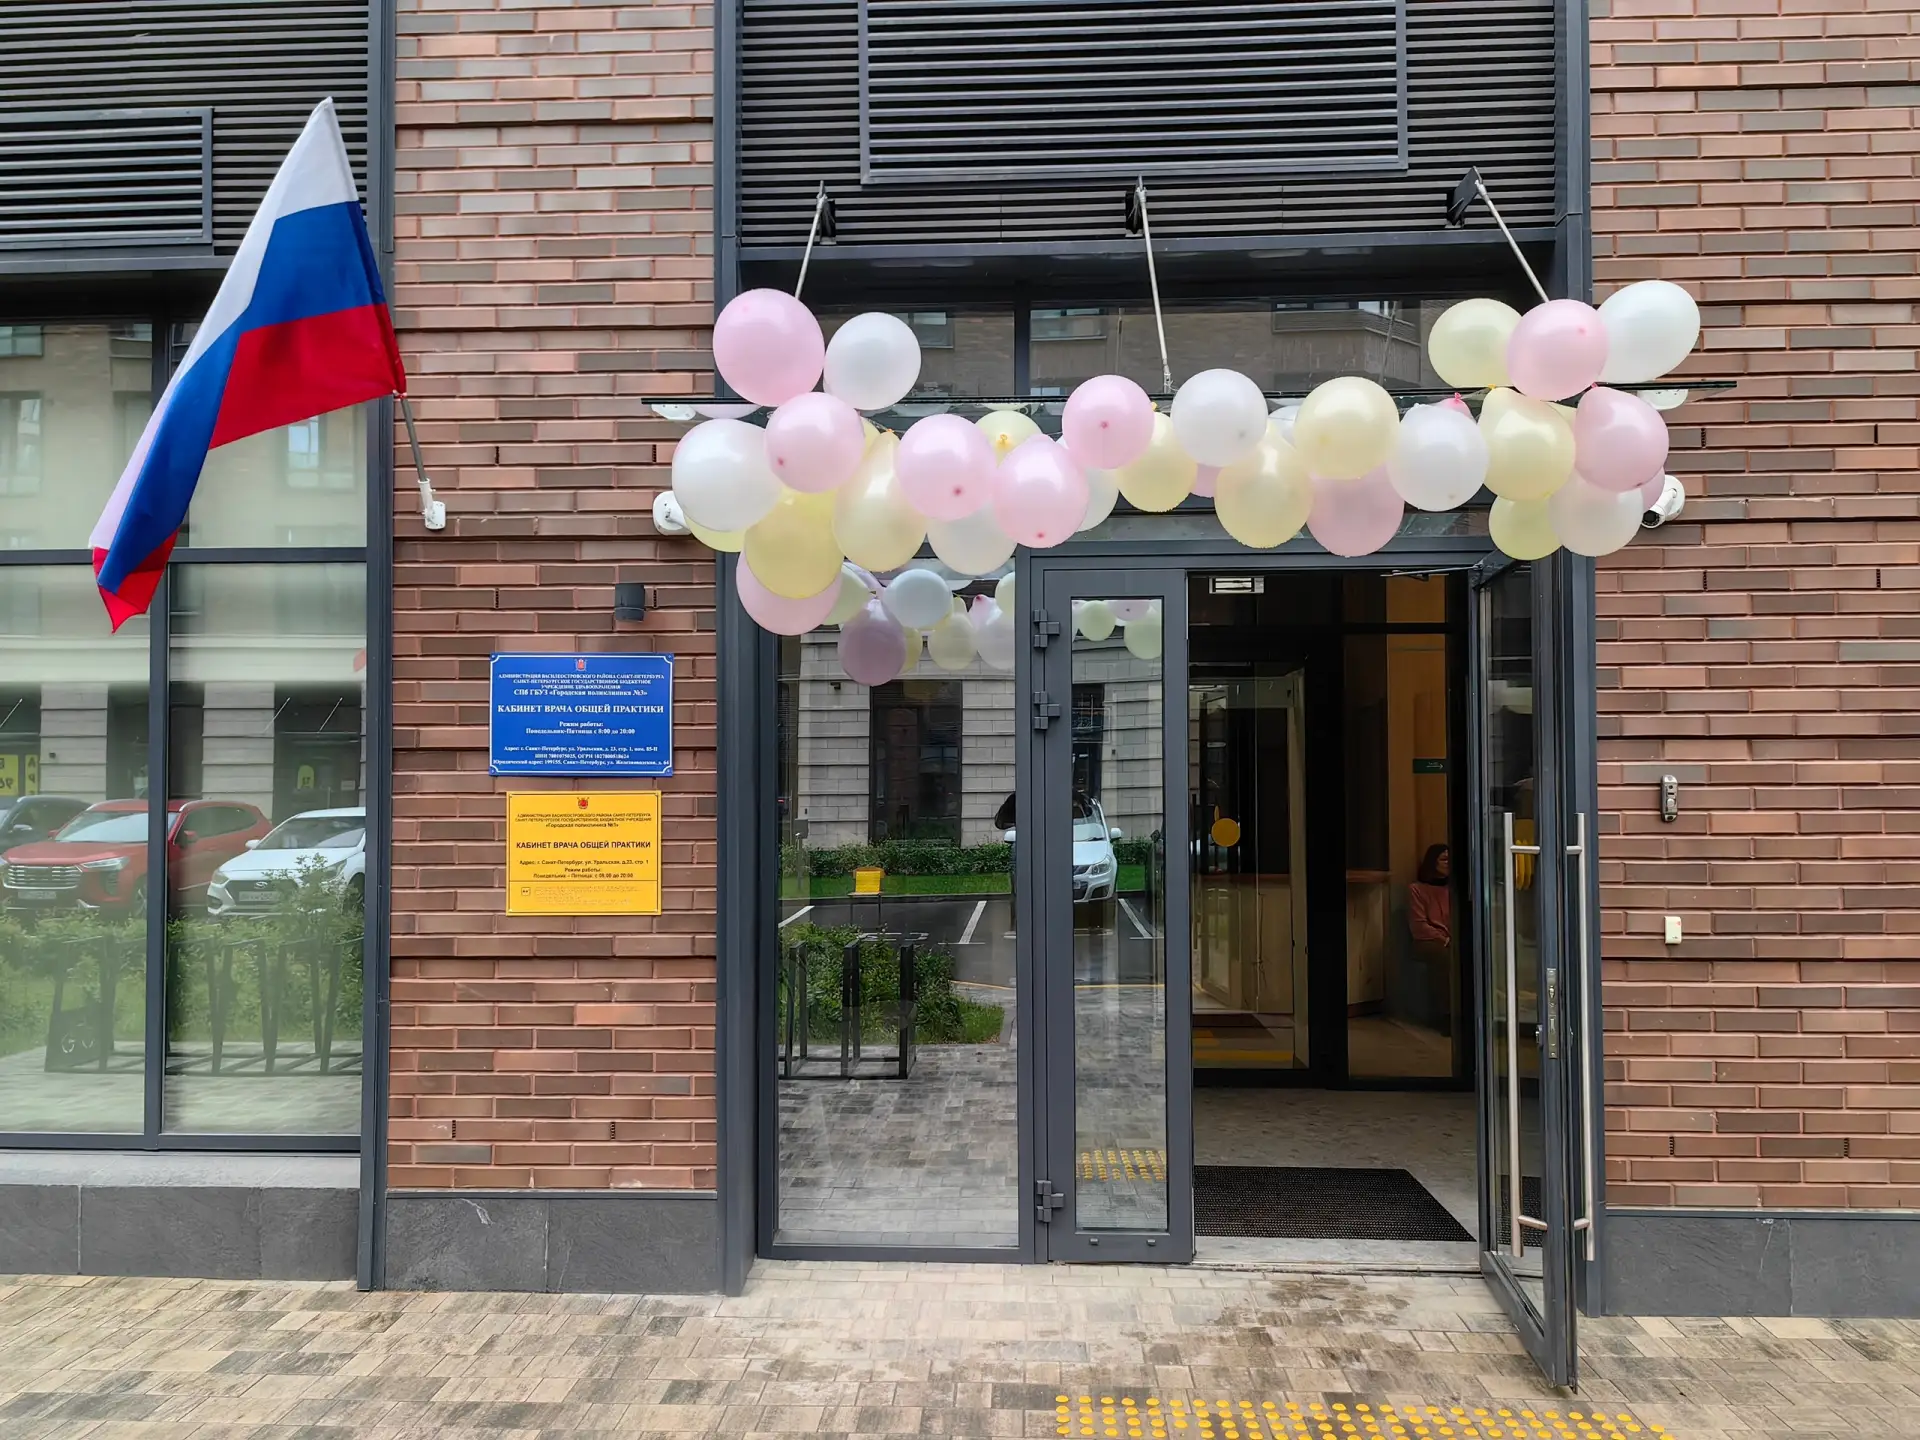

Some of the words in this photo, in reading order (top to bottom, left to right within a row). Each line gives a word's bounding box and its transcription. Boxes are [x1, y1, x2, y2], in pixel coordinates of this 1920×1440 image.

[498, 705, 541, 713] КАБИНЕТ
[544, 705, 573, 713] ВРАЧА
[574, 704, 611, 714] ОБЩЕЙ
[613, 705, 664, 713] ПРАКТИКИ
[580, 841, 609, 849] ОБЩЕЙ
